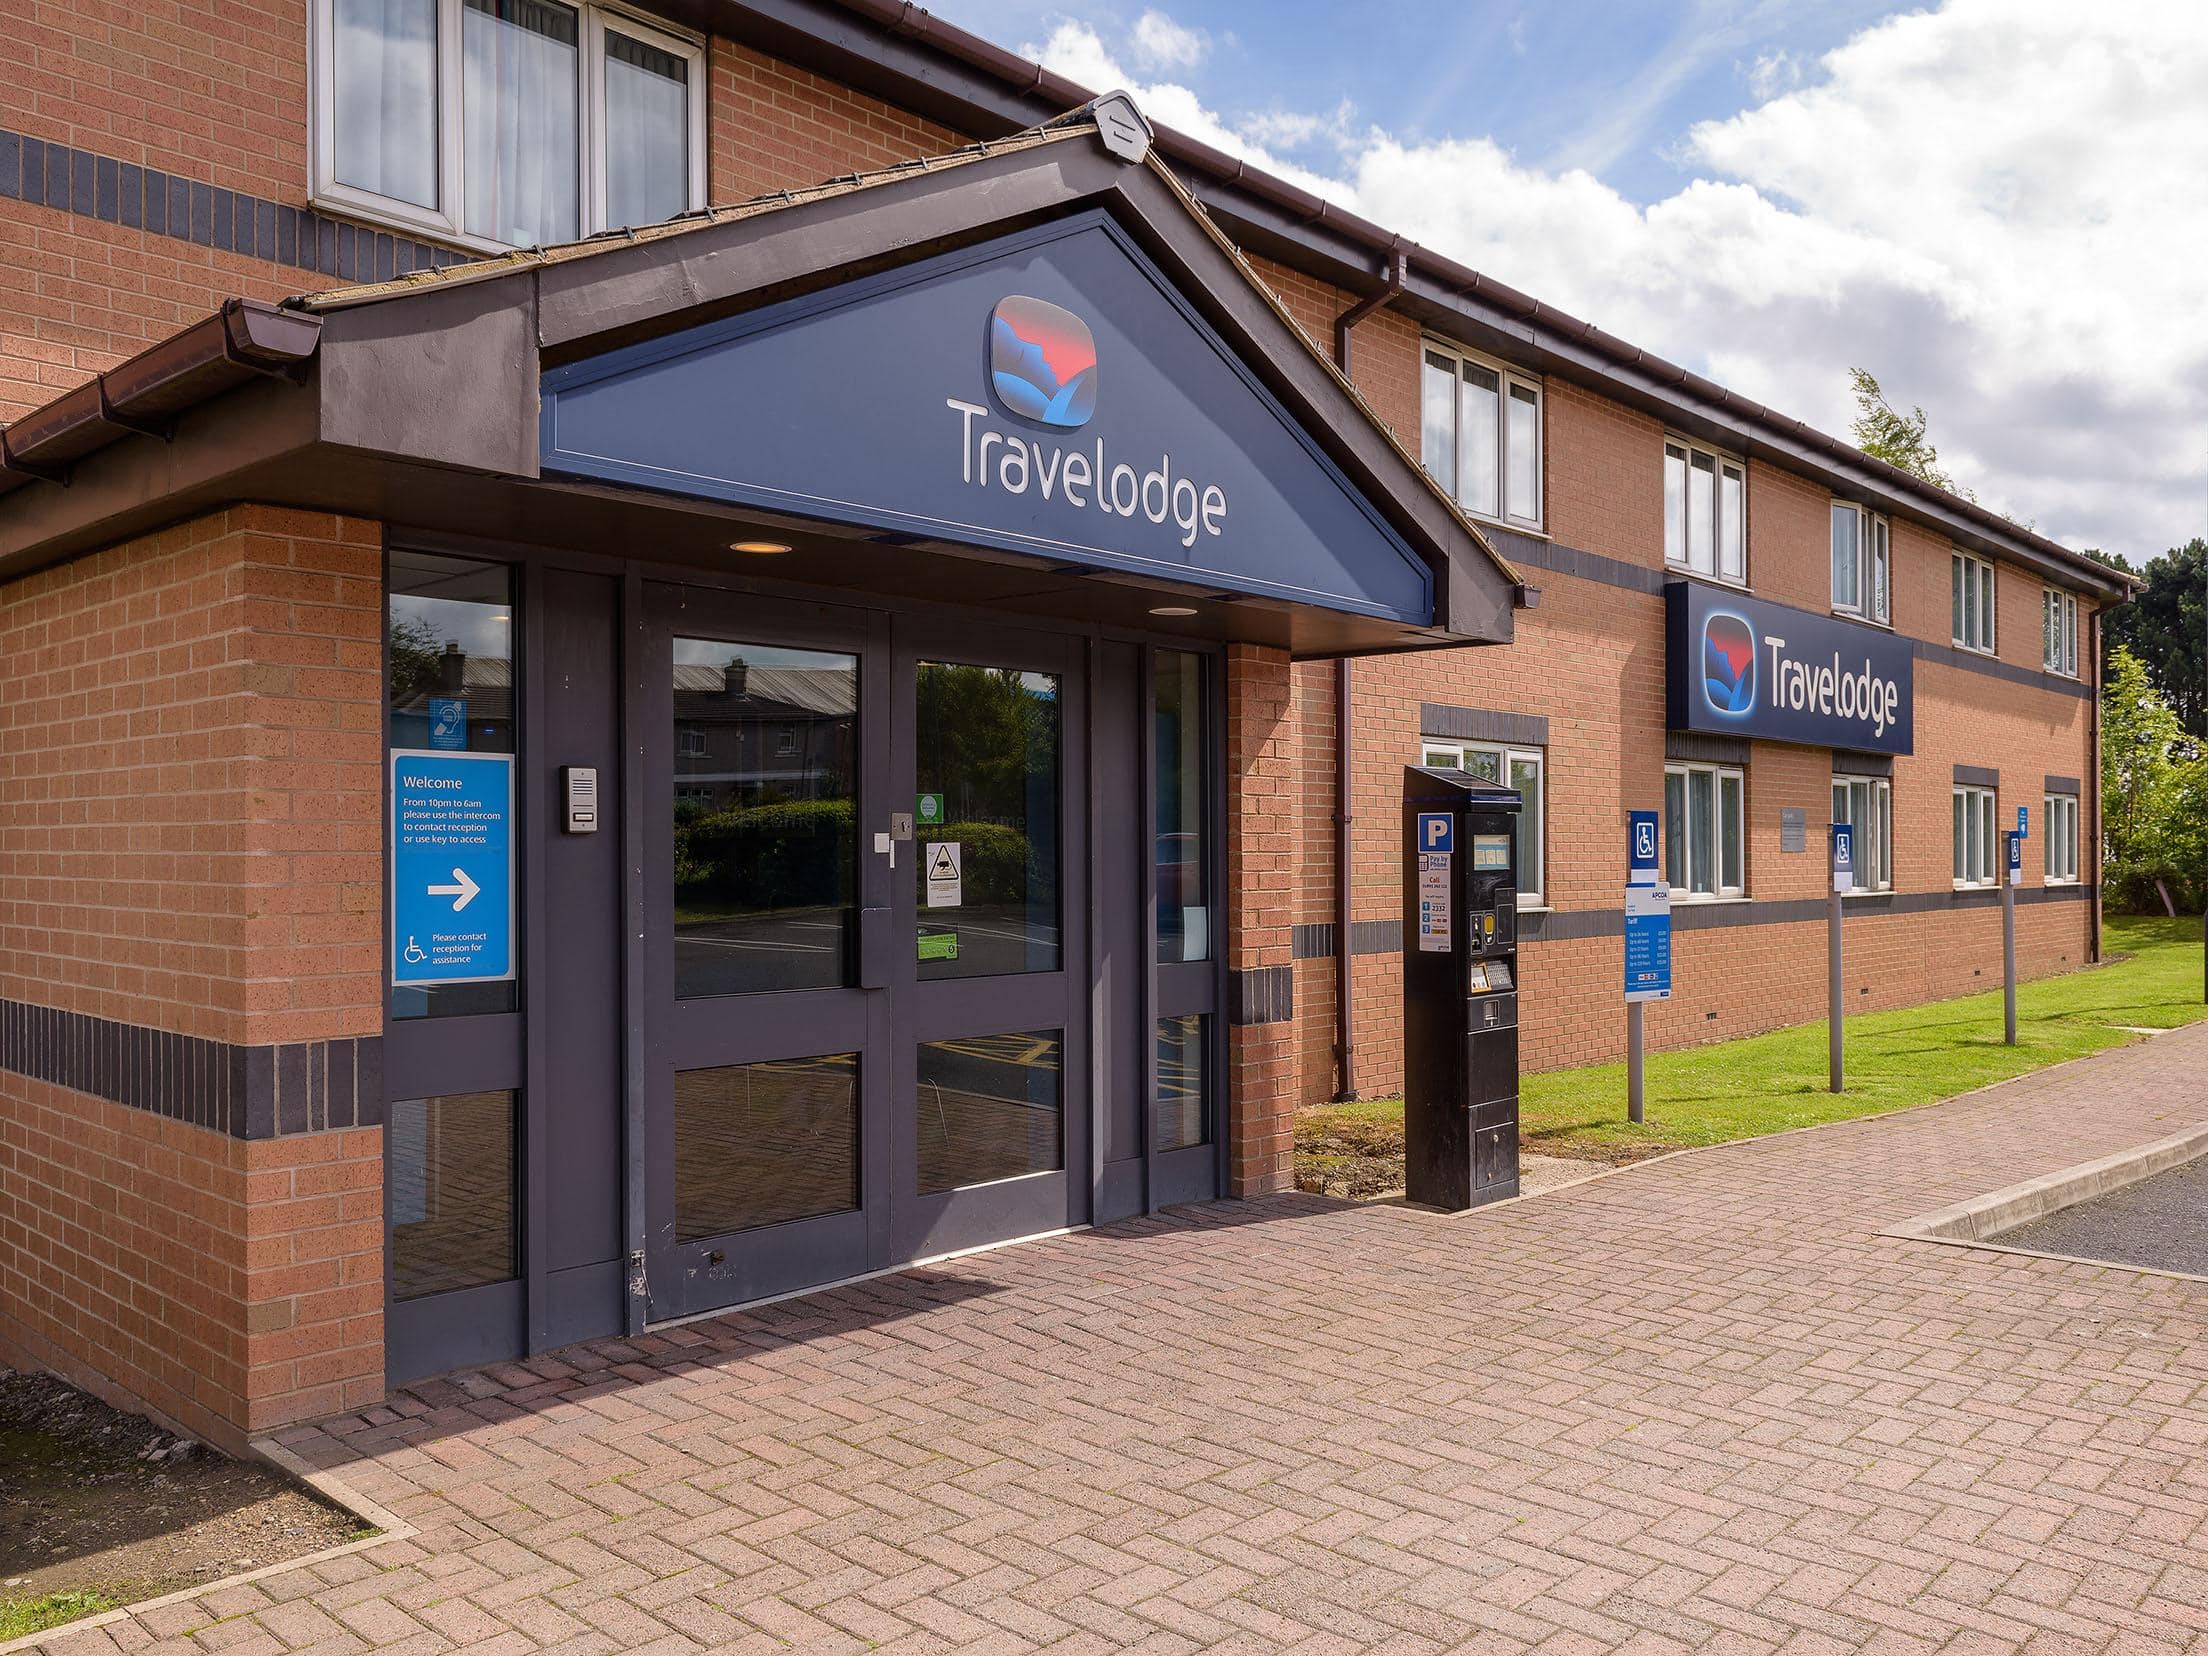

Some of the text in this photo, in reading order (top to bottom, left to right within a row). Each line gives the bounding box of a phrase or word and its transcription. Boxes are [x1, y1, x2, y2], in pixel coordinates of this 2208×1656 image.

[946, 398, 1228, 548] Travelodge
[1764, 635, 1898, 738] Travelodge
[403, 776, 463, 790] Welcome
[403, 798, 426, 807] From
[429, 799, 452, 809] 10pm
[453, 800, 463, 808] to
[403, 811, 431, 820] please
[449, 811, 463, 819] the
[464, 811, 501, 820] intercom
[403, 823, 488, 833] to contact reception
[1428, 820, 1448, 846] P
[432, 835, 448, 845] key
[432, 933, 487, 942] Please contact
[432, 943, 482, 954] reception for
[432, 956, 472, 964] assistance
